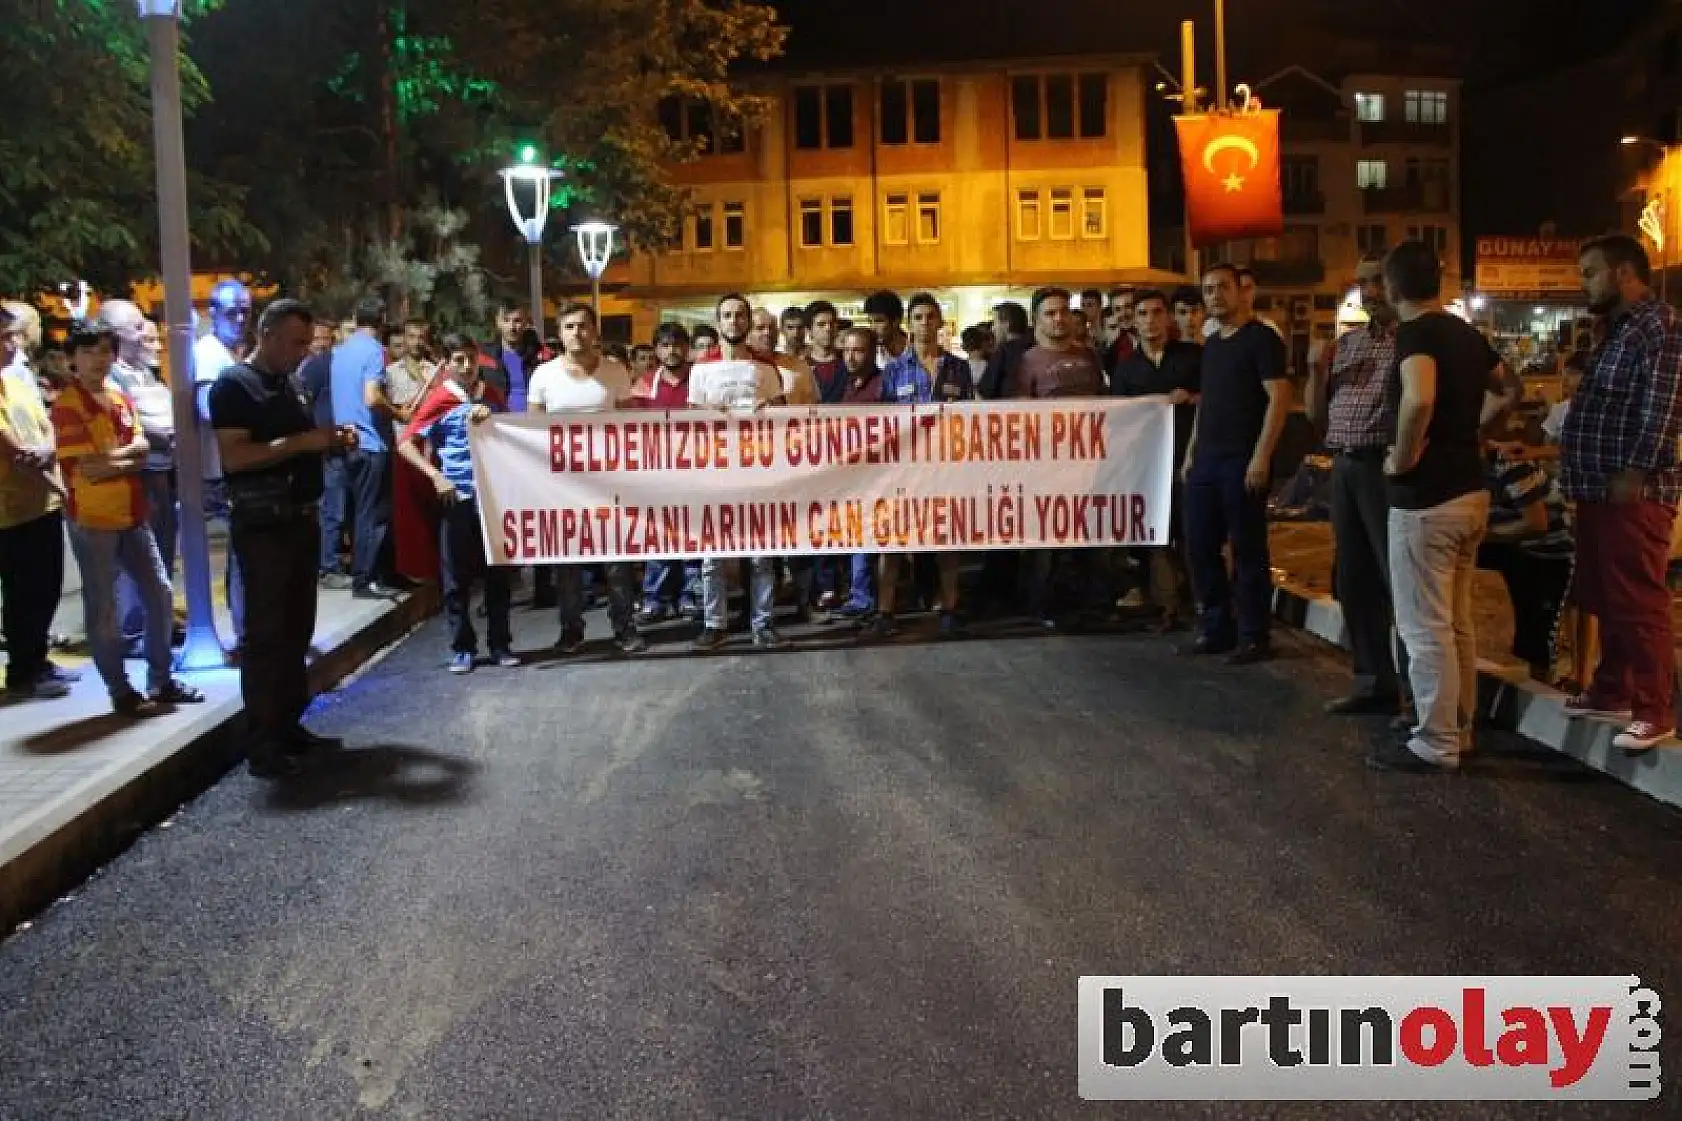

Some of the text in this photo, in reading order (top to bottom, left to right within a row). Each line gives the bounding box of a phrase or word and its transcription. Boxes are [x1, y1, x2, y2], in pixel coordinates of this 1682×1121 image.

[549, 404, 1107, 472] BELDEMİZDE BU GÜNDEN İTİBAREN PKK
[503, 484, 1156, 558] SEMPATİZANLARININ CAN GÜVENLİĞİ YOKTUR.
